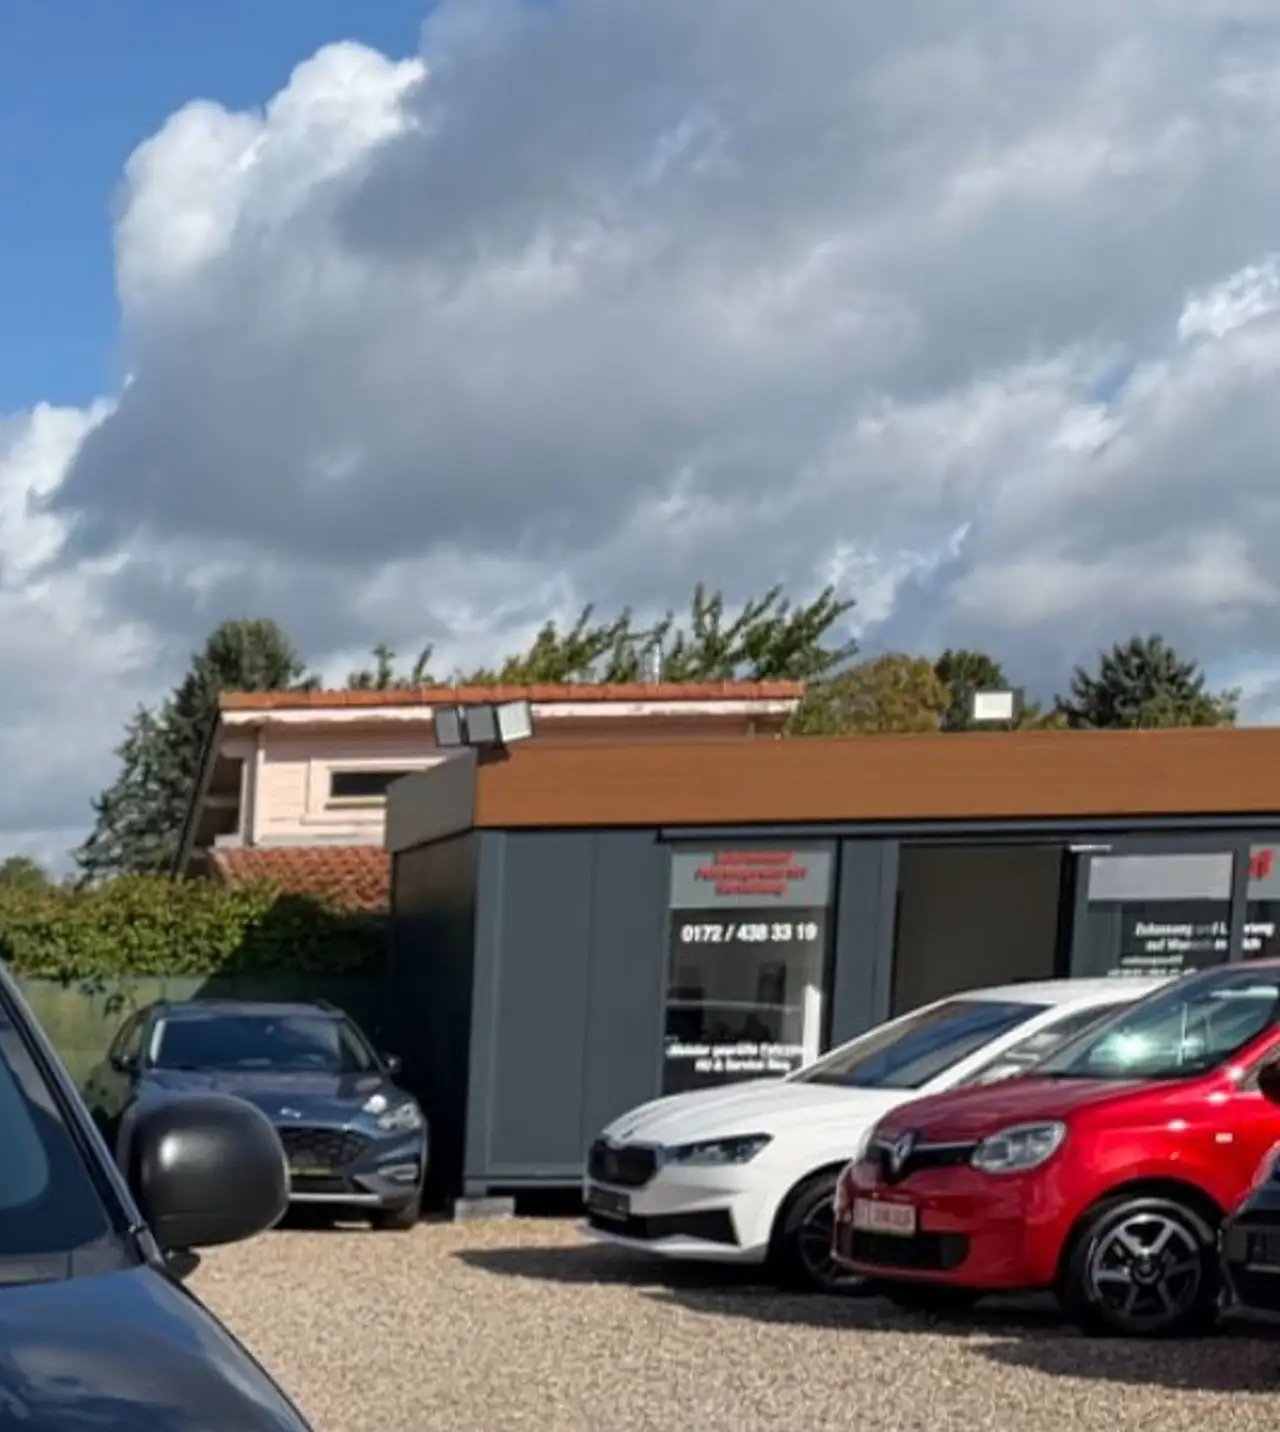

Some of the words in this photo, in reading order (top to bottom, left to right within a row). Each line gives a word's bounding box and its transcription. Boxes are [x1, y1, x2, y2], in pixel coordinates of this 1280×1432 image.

[681, 924, 724, 943] 0172
[737, 924, 770, 943] 438
[771, 924, 795, 942] 33
[797, 923, 819, 941] 19
